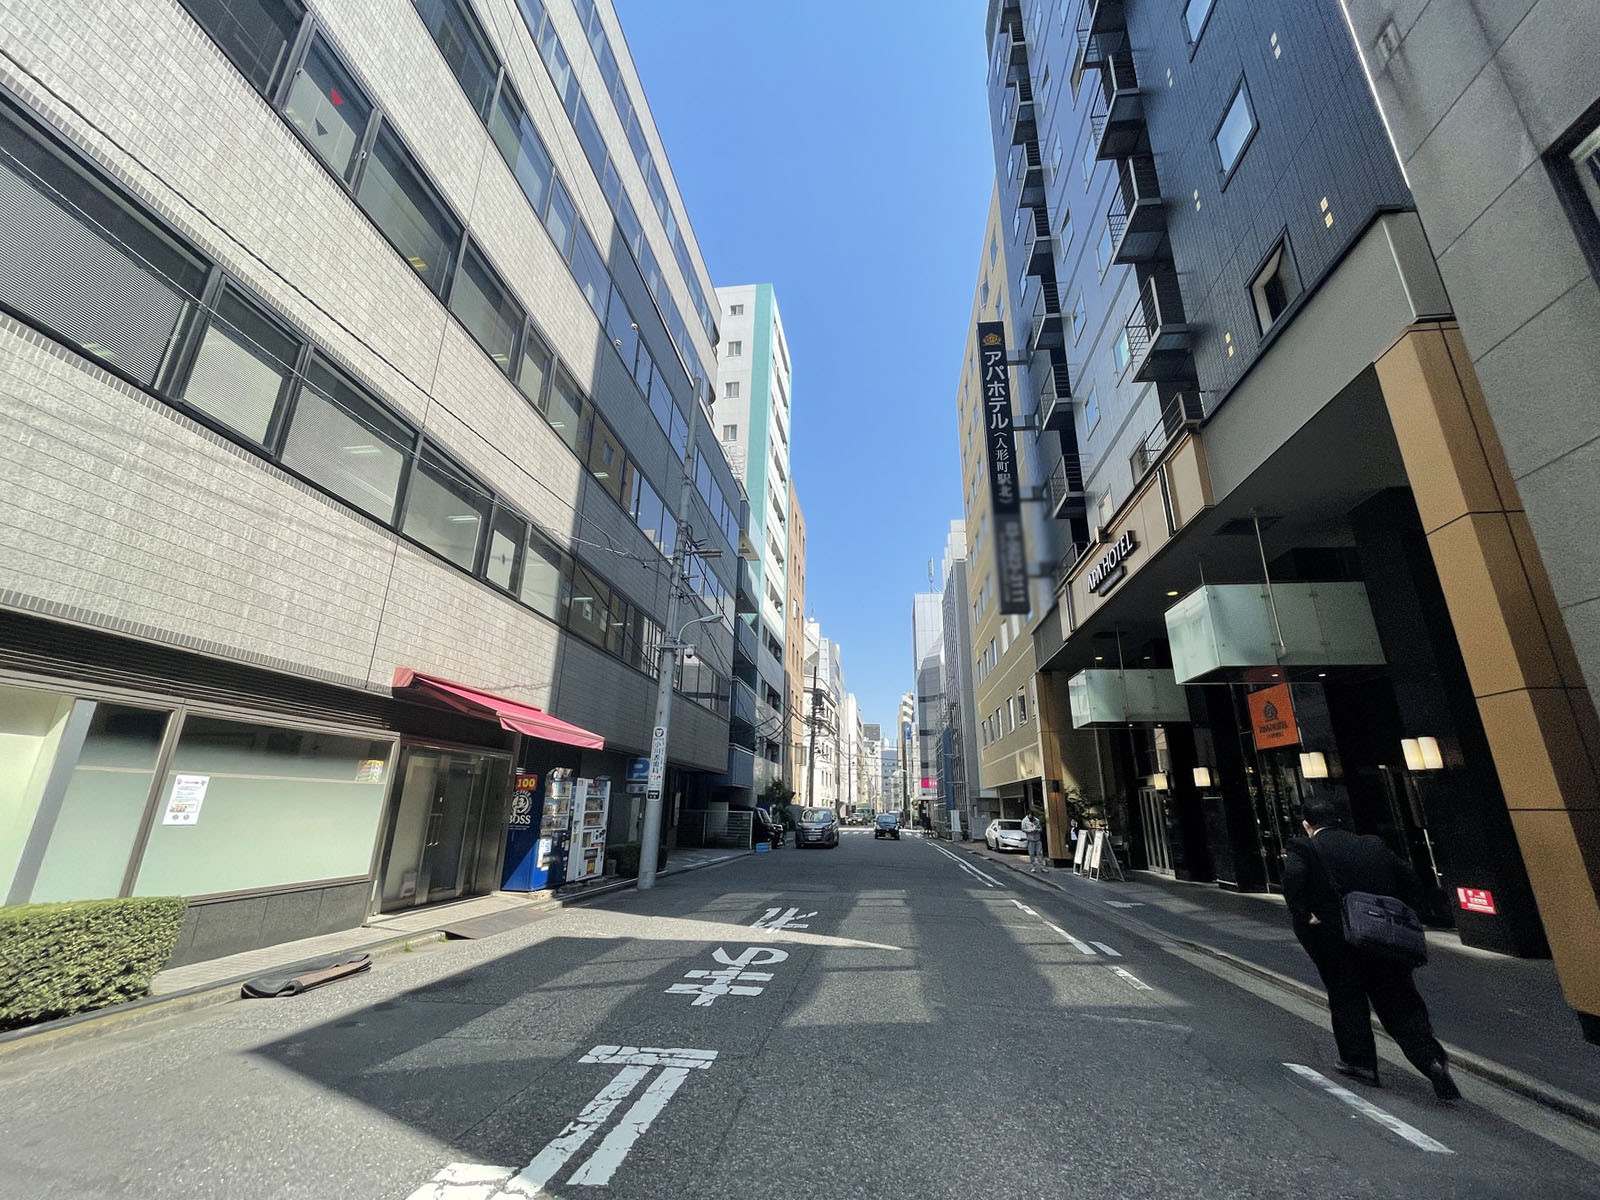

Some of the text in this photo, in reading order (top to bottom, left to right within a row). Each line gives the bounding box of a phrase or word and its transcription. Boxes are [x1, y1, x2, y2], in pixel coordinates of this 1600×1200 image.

[1087, 564, 1103, 593] APA
[1102, 531, 1133, 576] HOTEL
[517, 778, 536, 788] 100
